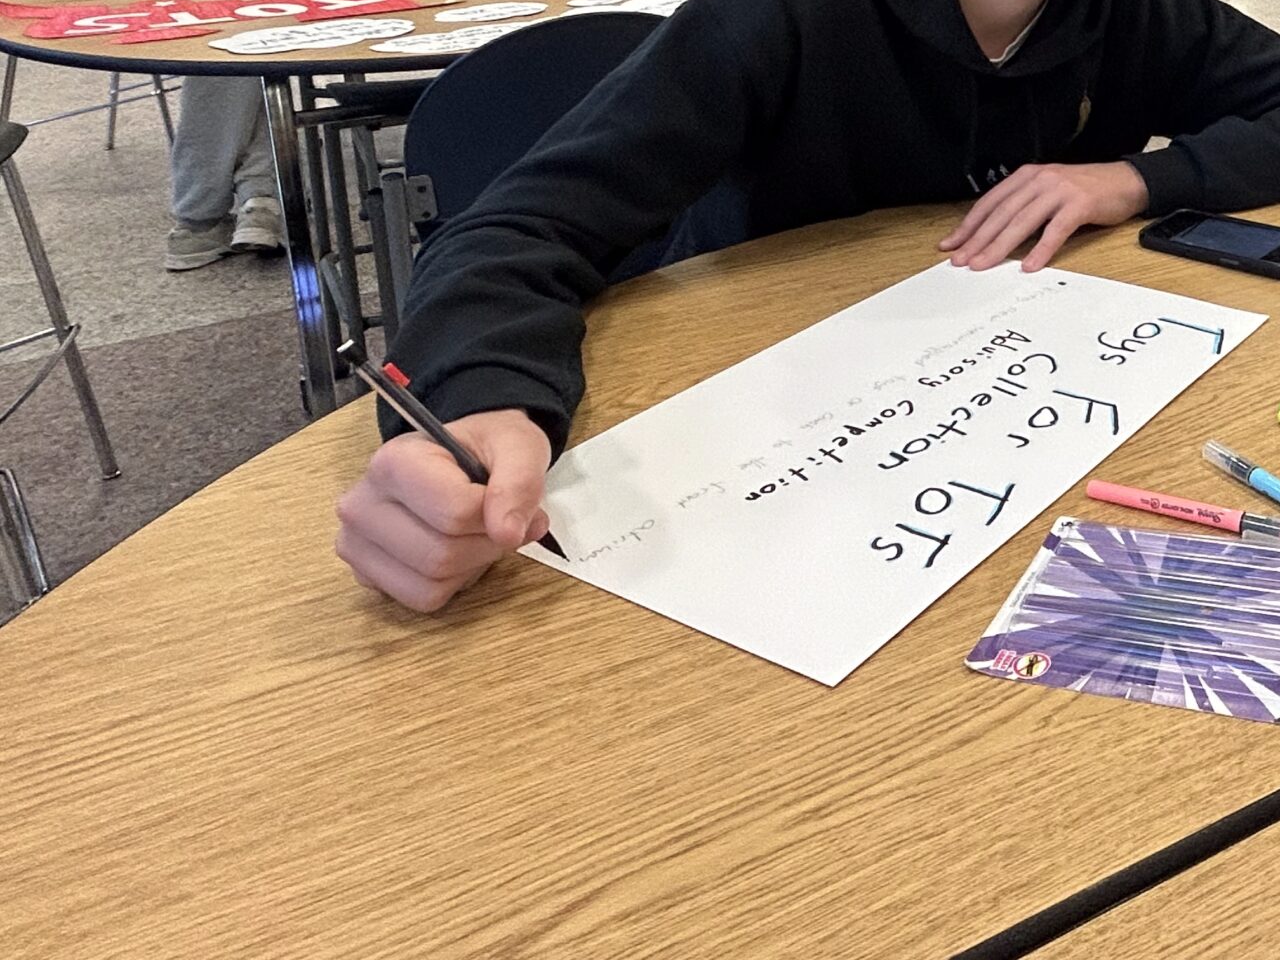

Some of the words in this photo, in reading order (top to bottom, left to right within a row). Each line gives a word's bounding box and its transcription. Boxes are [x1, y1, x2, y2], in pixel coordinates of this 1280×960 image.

[917, 327, 1033, 389] Advisory
[1098, 316, 1226, 366] Toys
[877, 352, 1059, 471] Collection
[1004, 388, 1120, 450] For
[743, 398, 916, 504] Competition
